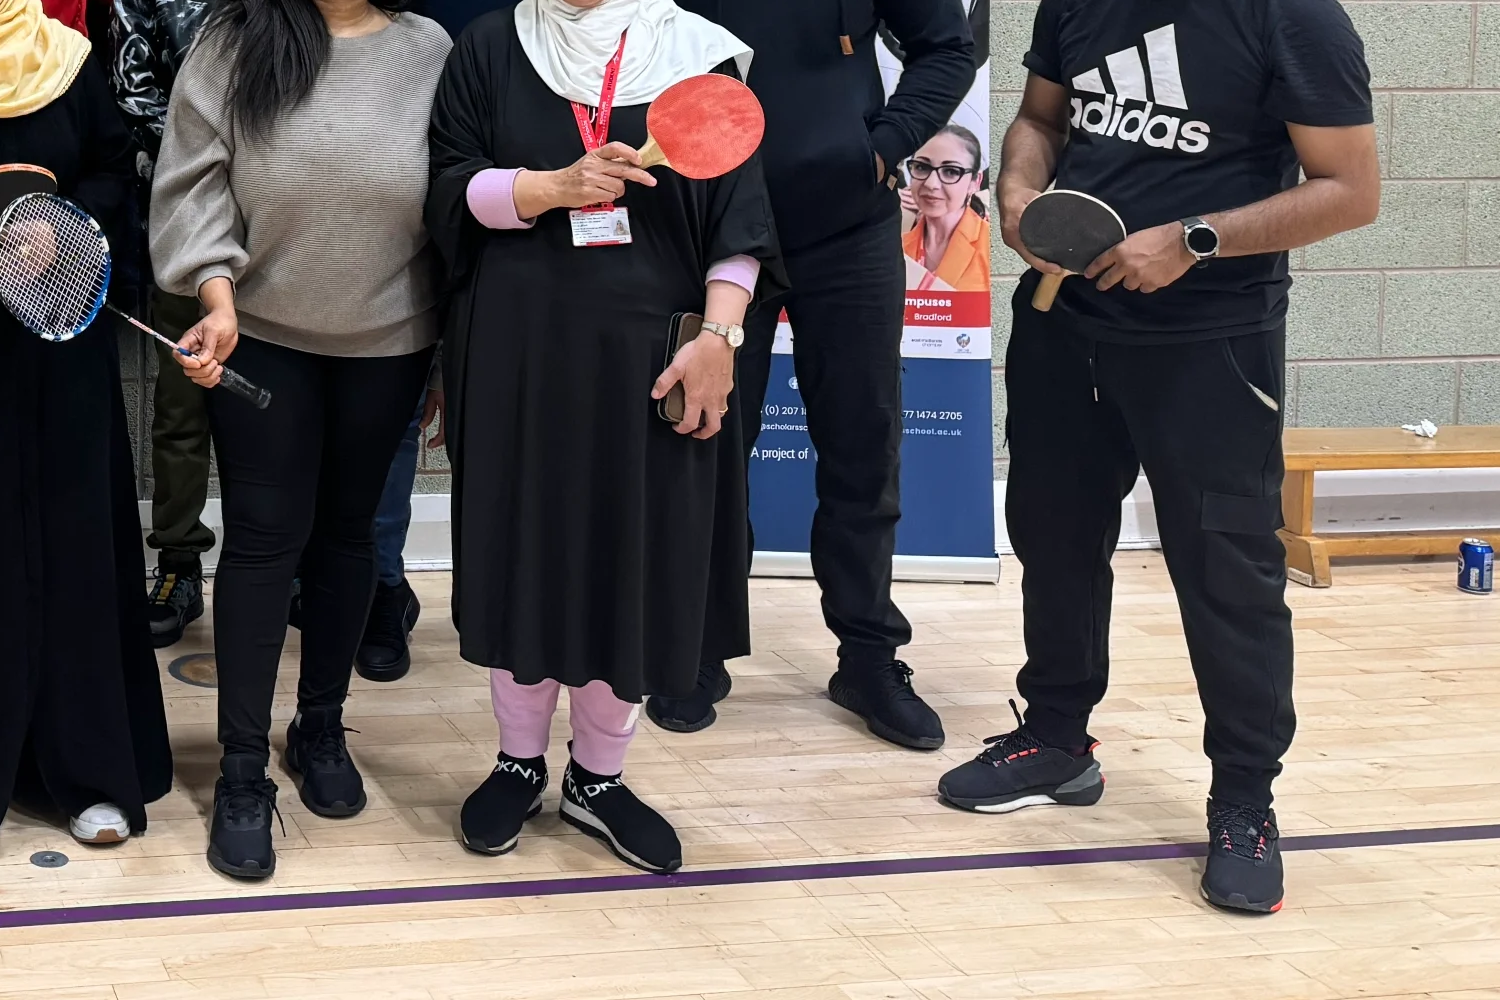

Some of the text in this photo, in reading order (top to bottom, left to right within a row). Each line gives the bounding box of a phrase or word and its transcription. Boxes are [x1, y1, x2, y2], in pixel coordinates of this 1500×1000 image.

[914, 313, 952, 322] Bradford
[765, 404, 780, 416] (0)
[781, 406, 799, 415] 207
[916, 410, 937, 420] 1474
[939, 411, 963, 421] 2705
[750, 446, 809, 461] A project of
